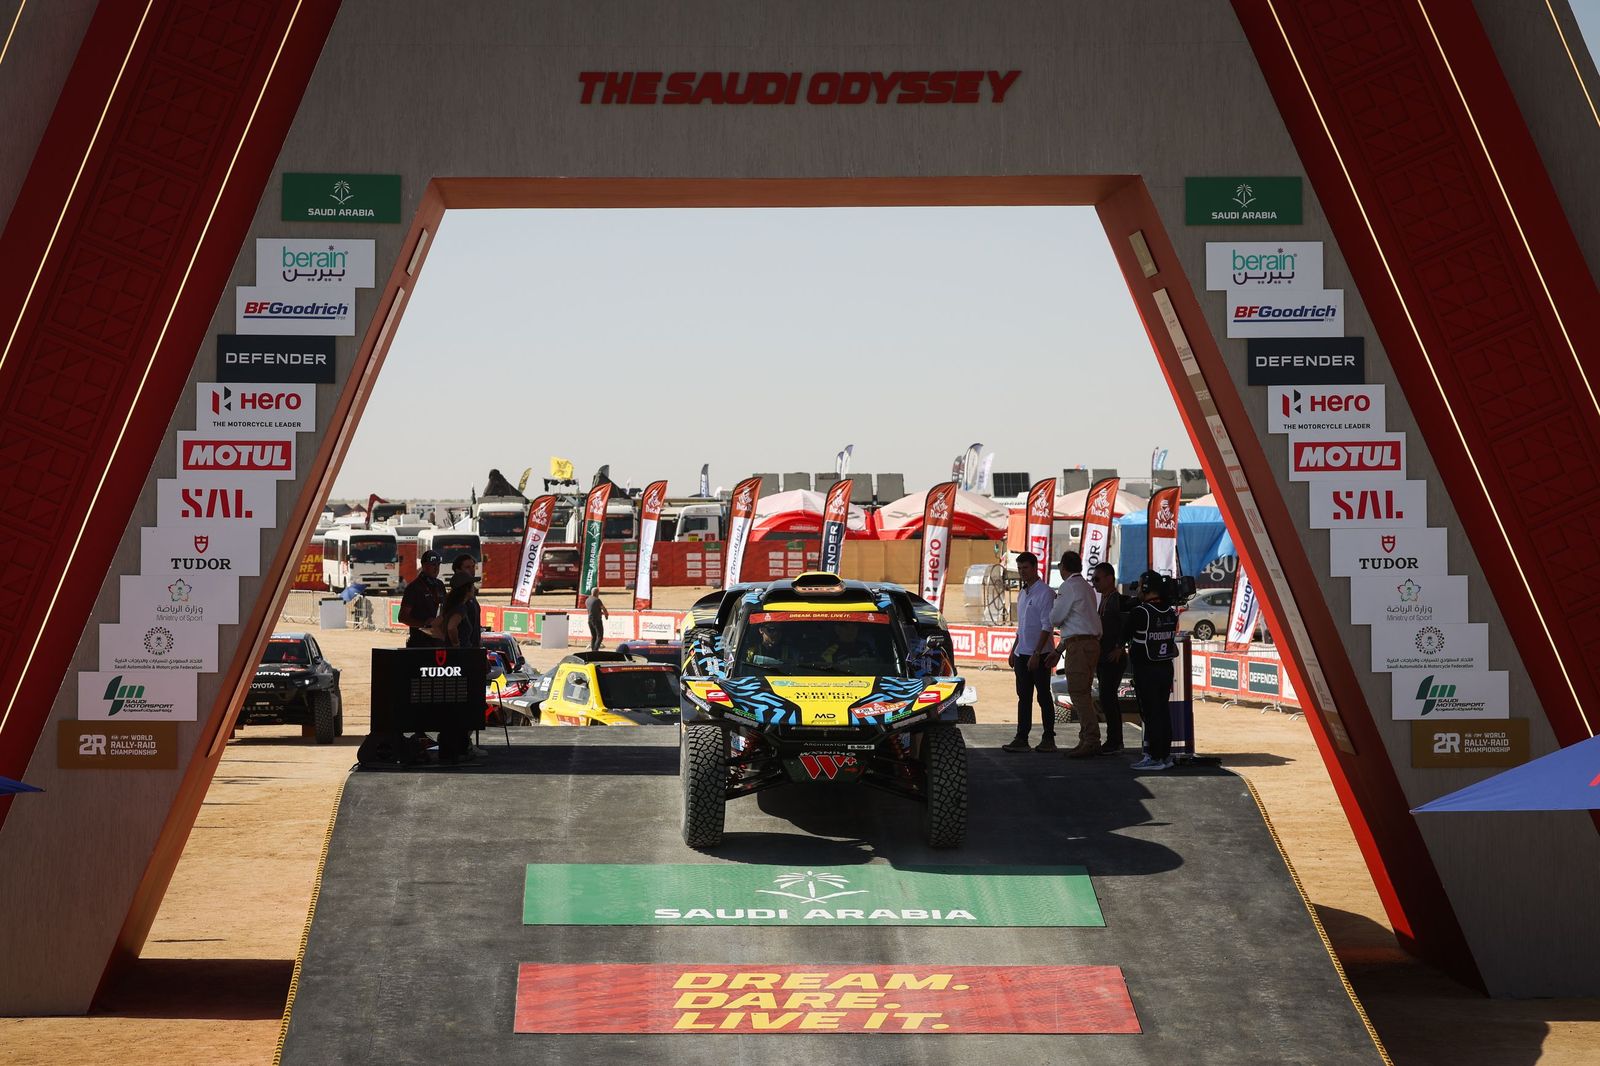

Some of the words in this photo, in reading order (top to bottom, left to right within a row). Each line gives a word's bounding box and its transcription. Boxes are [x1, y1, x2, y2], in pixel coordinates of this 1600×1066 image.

[578, 71, 663, 105] THE
[663, 71, 802, 105] SAUDI
[805, 70, 1022, 104] ODYSSEY
[308, 208, 336, 216] SAUDI
[339, 208, 375, 217] ARABIA
[1211, 211, 1240, 220] SAUDI
[1241, 211, 1278, 219] ARABIA
[283, 245, 346, 268] berain
[1232, 248, 1295, 270] berain
[282, 268, 345, 282] بيرين
[1232, 271, 1295, 285] بيرين
[244, 302, 348, 315] BFGoodrich
[1234, 305, 1336, 318] BFGoodrich
[225, 352, 327, 365] DEFENDER
[1255, 355, 1356, 368] DEFENDER
[240, 392, 302, 410] Hero
[1310, 394, 1371, 412] Hero
[187, 444, 287, 467] MOTUL
[1299, 445, 1397, 468] MOTUL
[181, 488, 253, 519] SAL
[1332, 490, 1404, 520] SAL
[929, 510, 948, 520] DAKAR
[1031, 508, 1050, 518] DAKAR
[1091, 508, 1110, 519] DAKAR
[1154, 519, 1176, 530] DAKAR
[589, 542, 597, 567] ARABIA
[928, 538, 942, 582] Hero
[171, 558, 231, 570] TUDOR
[522, 544, 539, 586] TUDOR
[1358, 557, 1419, 570] TUDOR
[585, 565, 594, 592] SAUDI
[156, 604, 183, 614] الرياضة
[184, 606, 203, 614] وزارة
[1234, 580, 1252, 633] BFGoo
[1386, 604, 1413, 614] الرياضة
[1414, 605, 1433, 614] وزارة
[156, 614, 178, 622] Ministry
[186, 614, 203, 622] Sport
[1386, 614, 1408, 622] Ministry
[1416, 614, 1433, 622] Sport
[1149, 632, 1171, 641] PODIUM
[420, 666, 462, 677] TUDOR
[1211, 667, 1238, 681] DEFENDER
[1250, 671, 1278, 686] DEFENDER
[79, 734, 107, 755] 2R
[110, 741, 156, 749] RALLY-RAID
[1433, 732, 1461, 754] 2R
[1464, 739, 1509, 747] RALLY-RAID
[654, 908, 788, 920] SAUDI
[803, 908, 978, 921] ARABIA
[671, 972, 971, 991] DREAM.
[672, 992, 902, 1010] DARE.
[672, 1011, 848, 1030] LIVE
[863, 1011, 950, 1030] IT.
